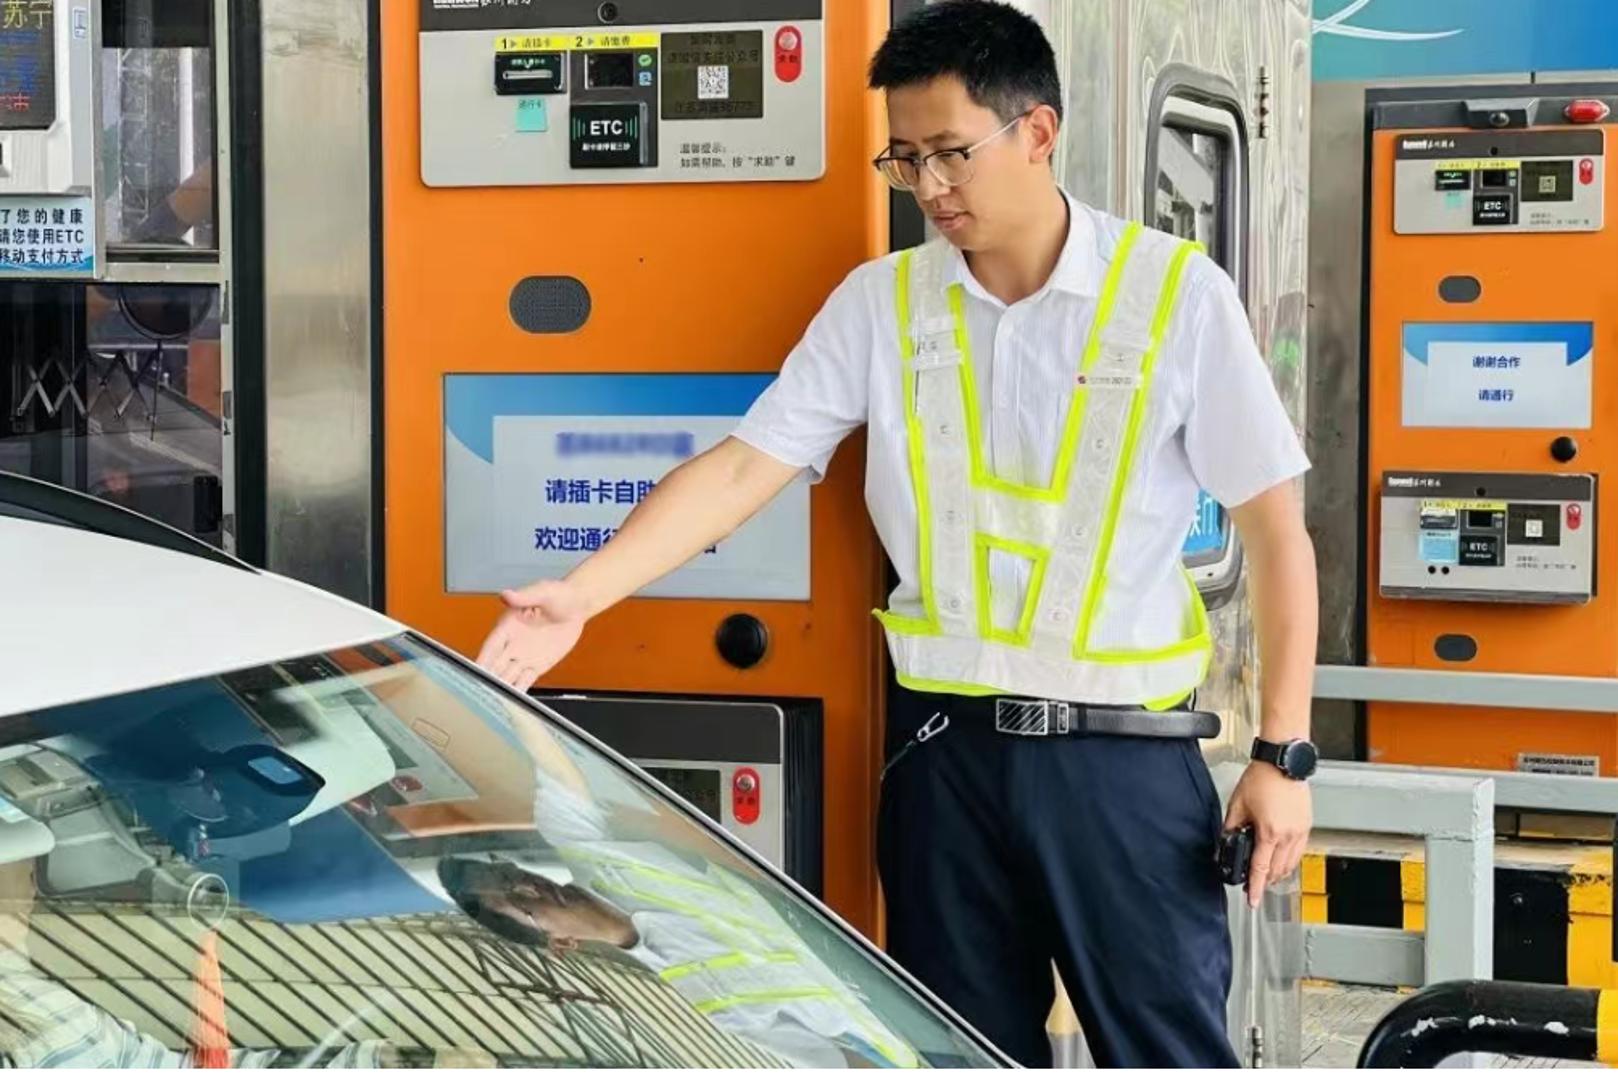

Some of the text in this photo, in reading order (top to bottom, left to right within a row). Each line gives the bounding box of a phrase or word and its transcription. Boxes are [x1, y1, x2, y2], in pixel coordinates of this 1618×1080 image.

[576, 36, 584, 47] 2
[590, 120, 623, 136] ETC
[1483, 202, 1503, 211] ETC
[0, 208, 84, 225] 了您的健康
[1473, 355, 1521, 369] 谢谢合作
[1478, 389, 1515, 402] 请通行
[1469, 542, 1489, 552] ETC
